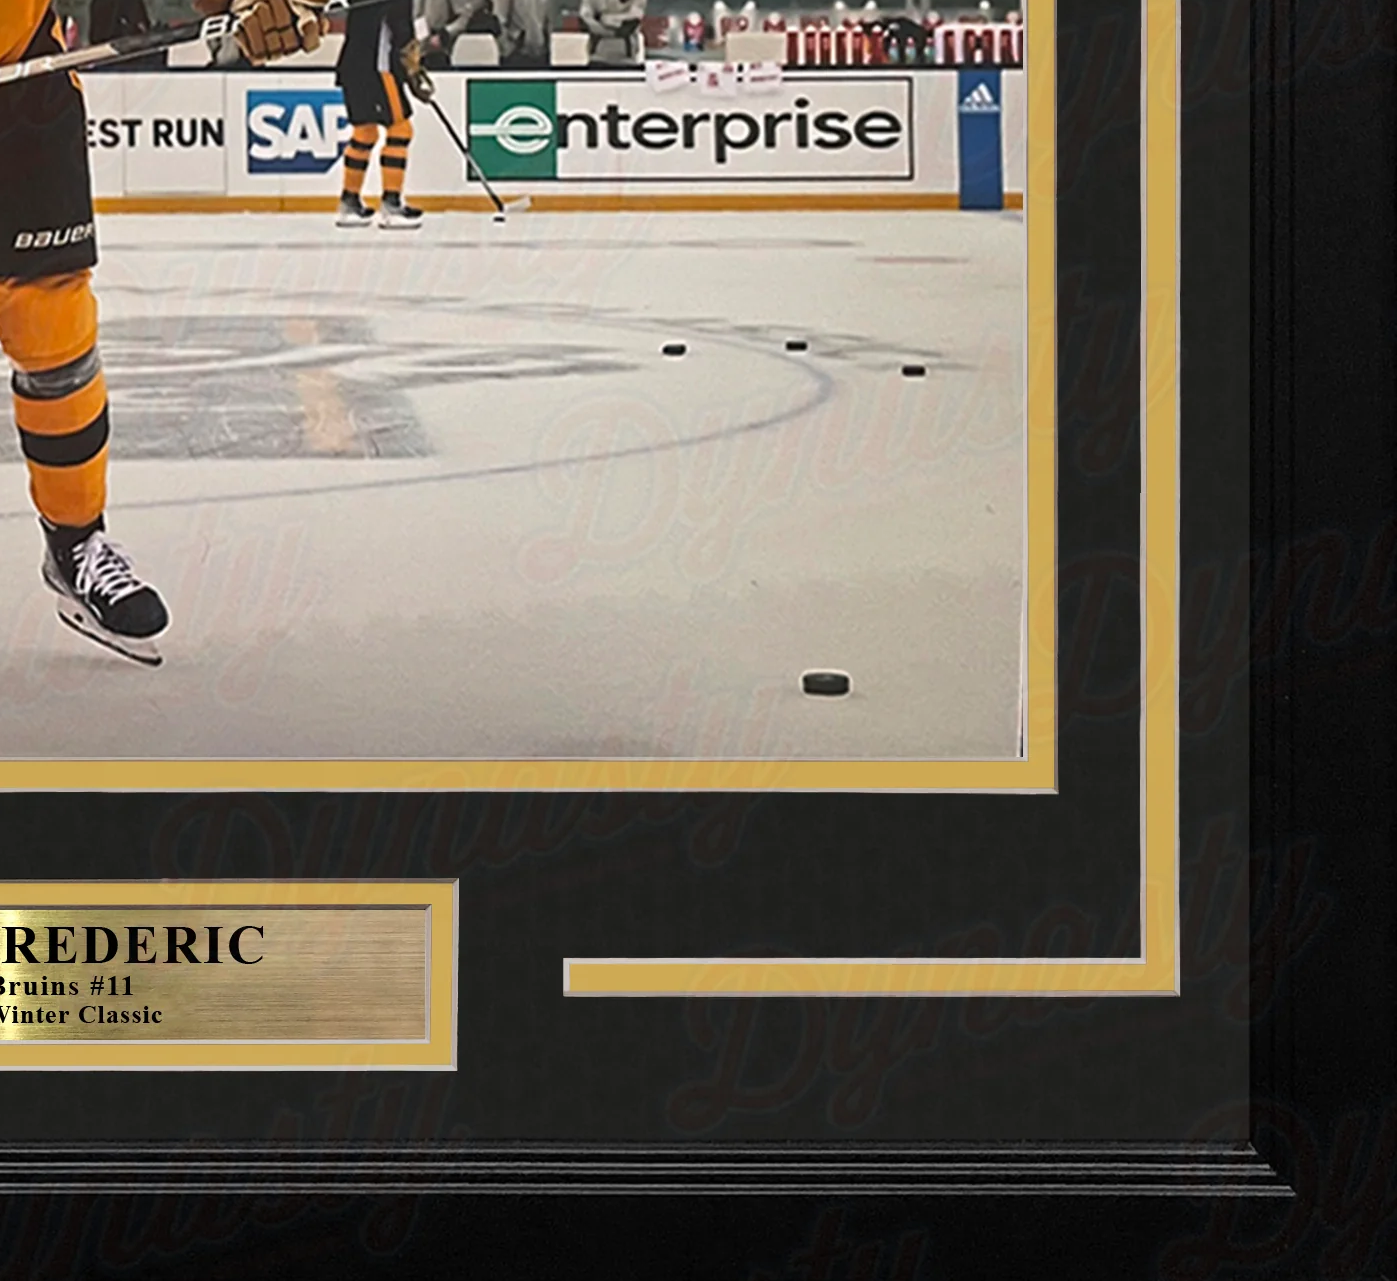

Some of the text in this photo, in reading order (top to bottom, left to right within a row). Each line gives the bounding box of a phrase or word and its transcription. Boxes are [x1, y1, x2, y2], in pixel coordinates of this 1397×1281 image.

[153, 118, 225, 148] RUN
[248, 103, 353, 161] SAP
[470, 98, 902, 165] enterprise
[90, 975, 134, 997] #11
[78, 1005, 164, 1025] Classic
